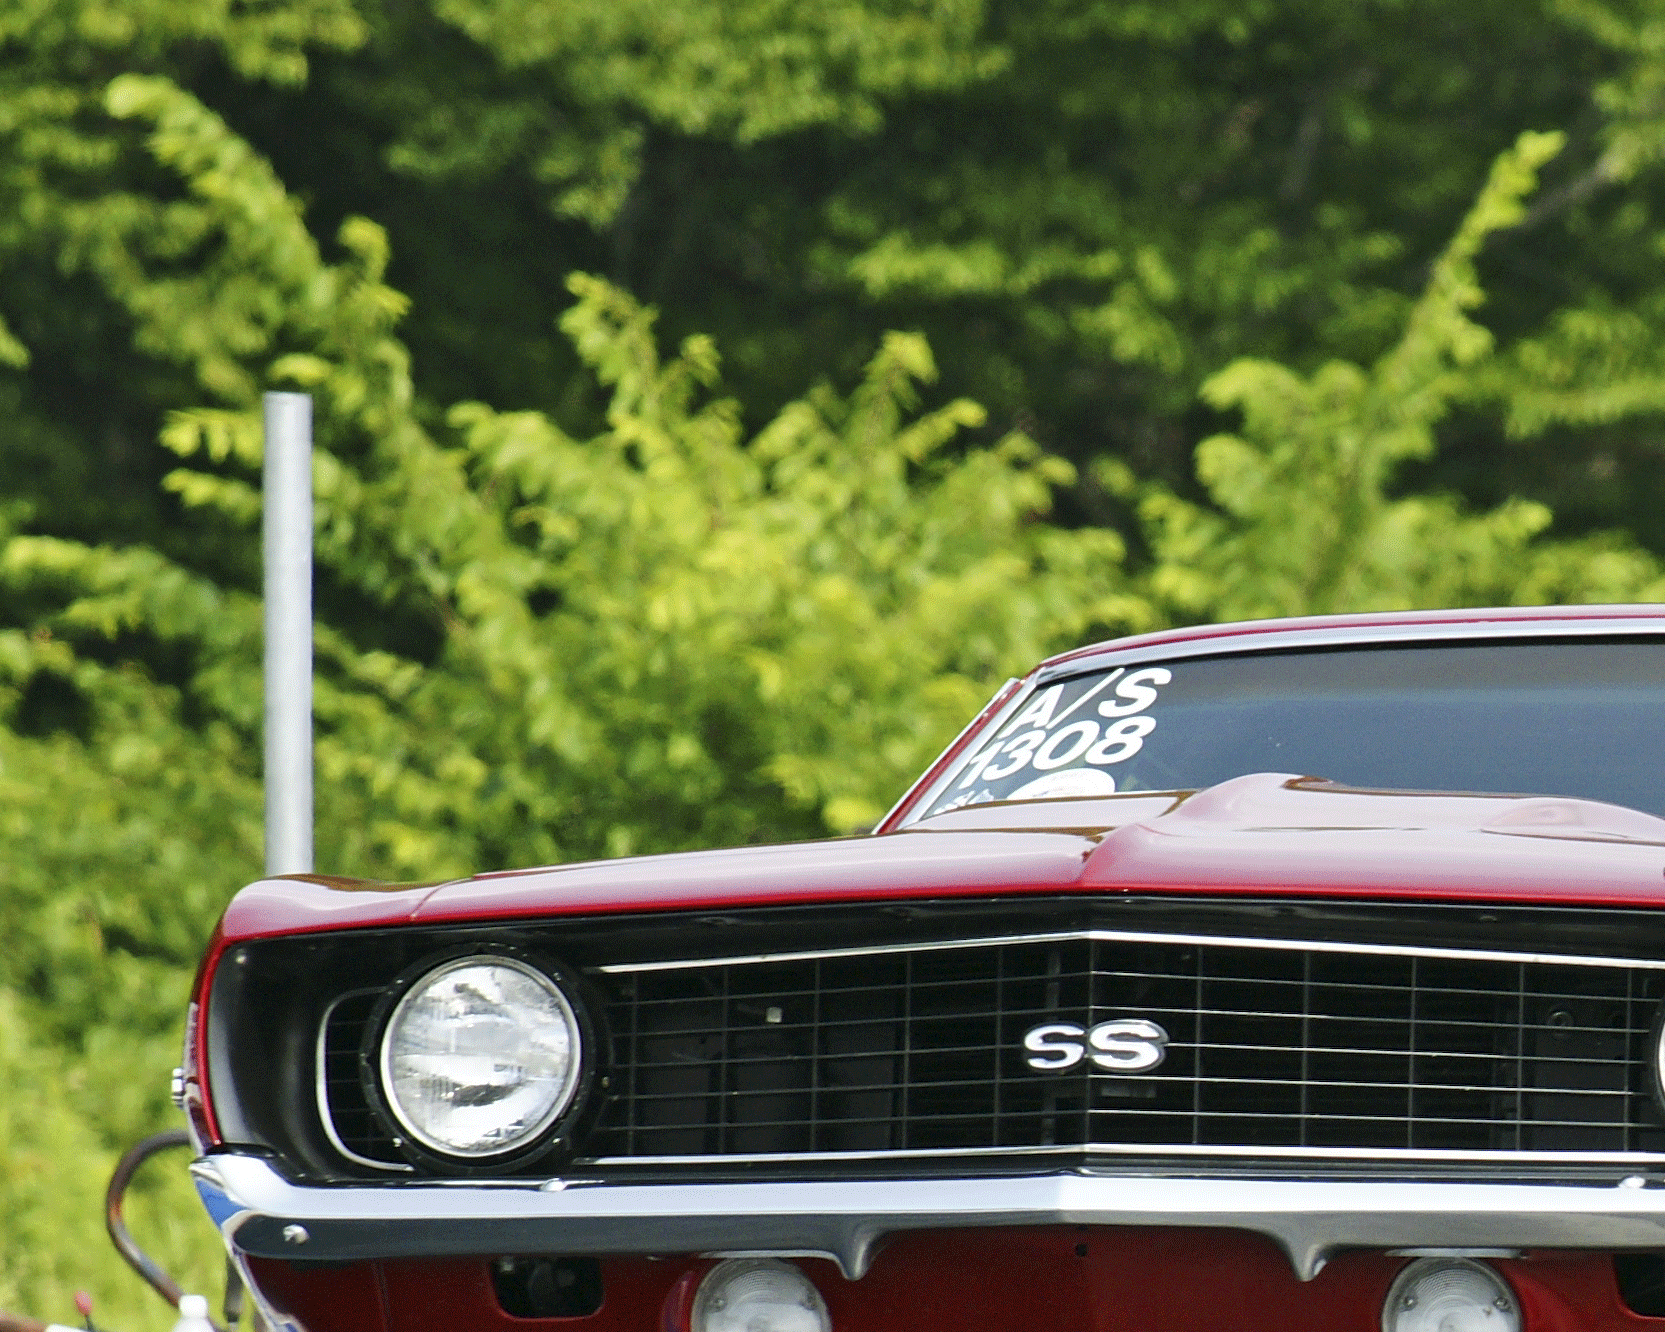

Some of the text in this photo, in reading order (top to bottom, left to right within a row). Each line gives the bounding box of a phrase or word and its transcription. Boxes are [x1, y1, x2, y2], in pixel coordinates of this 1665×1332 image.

[998, 667, 1172, 739] A/S
[959, 715, 1157, 790] 1308
[1024, 1019, 1169, 1073] SS
